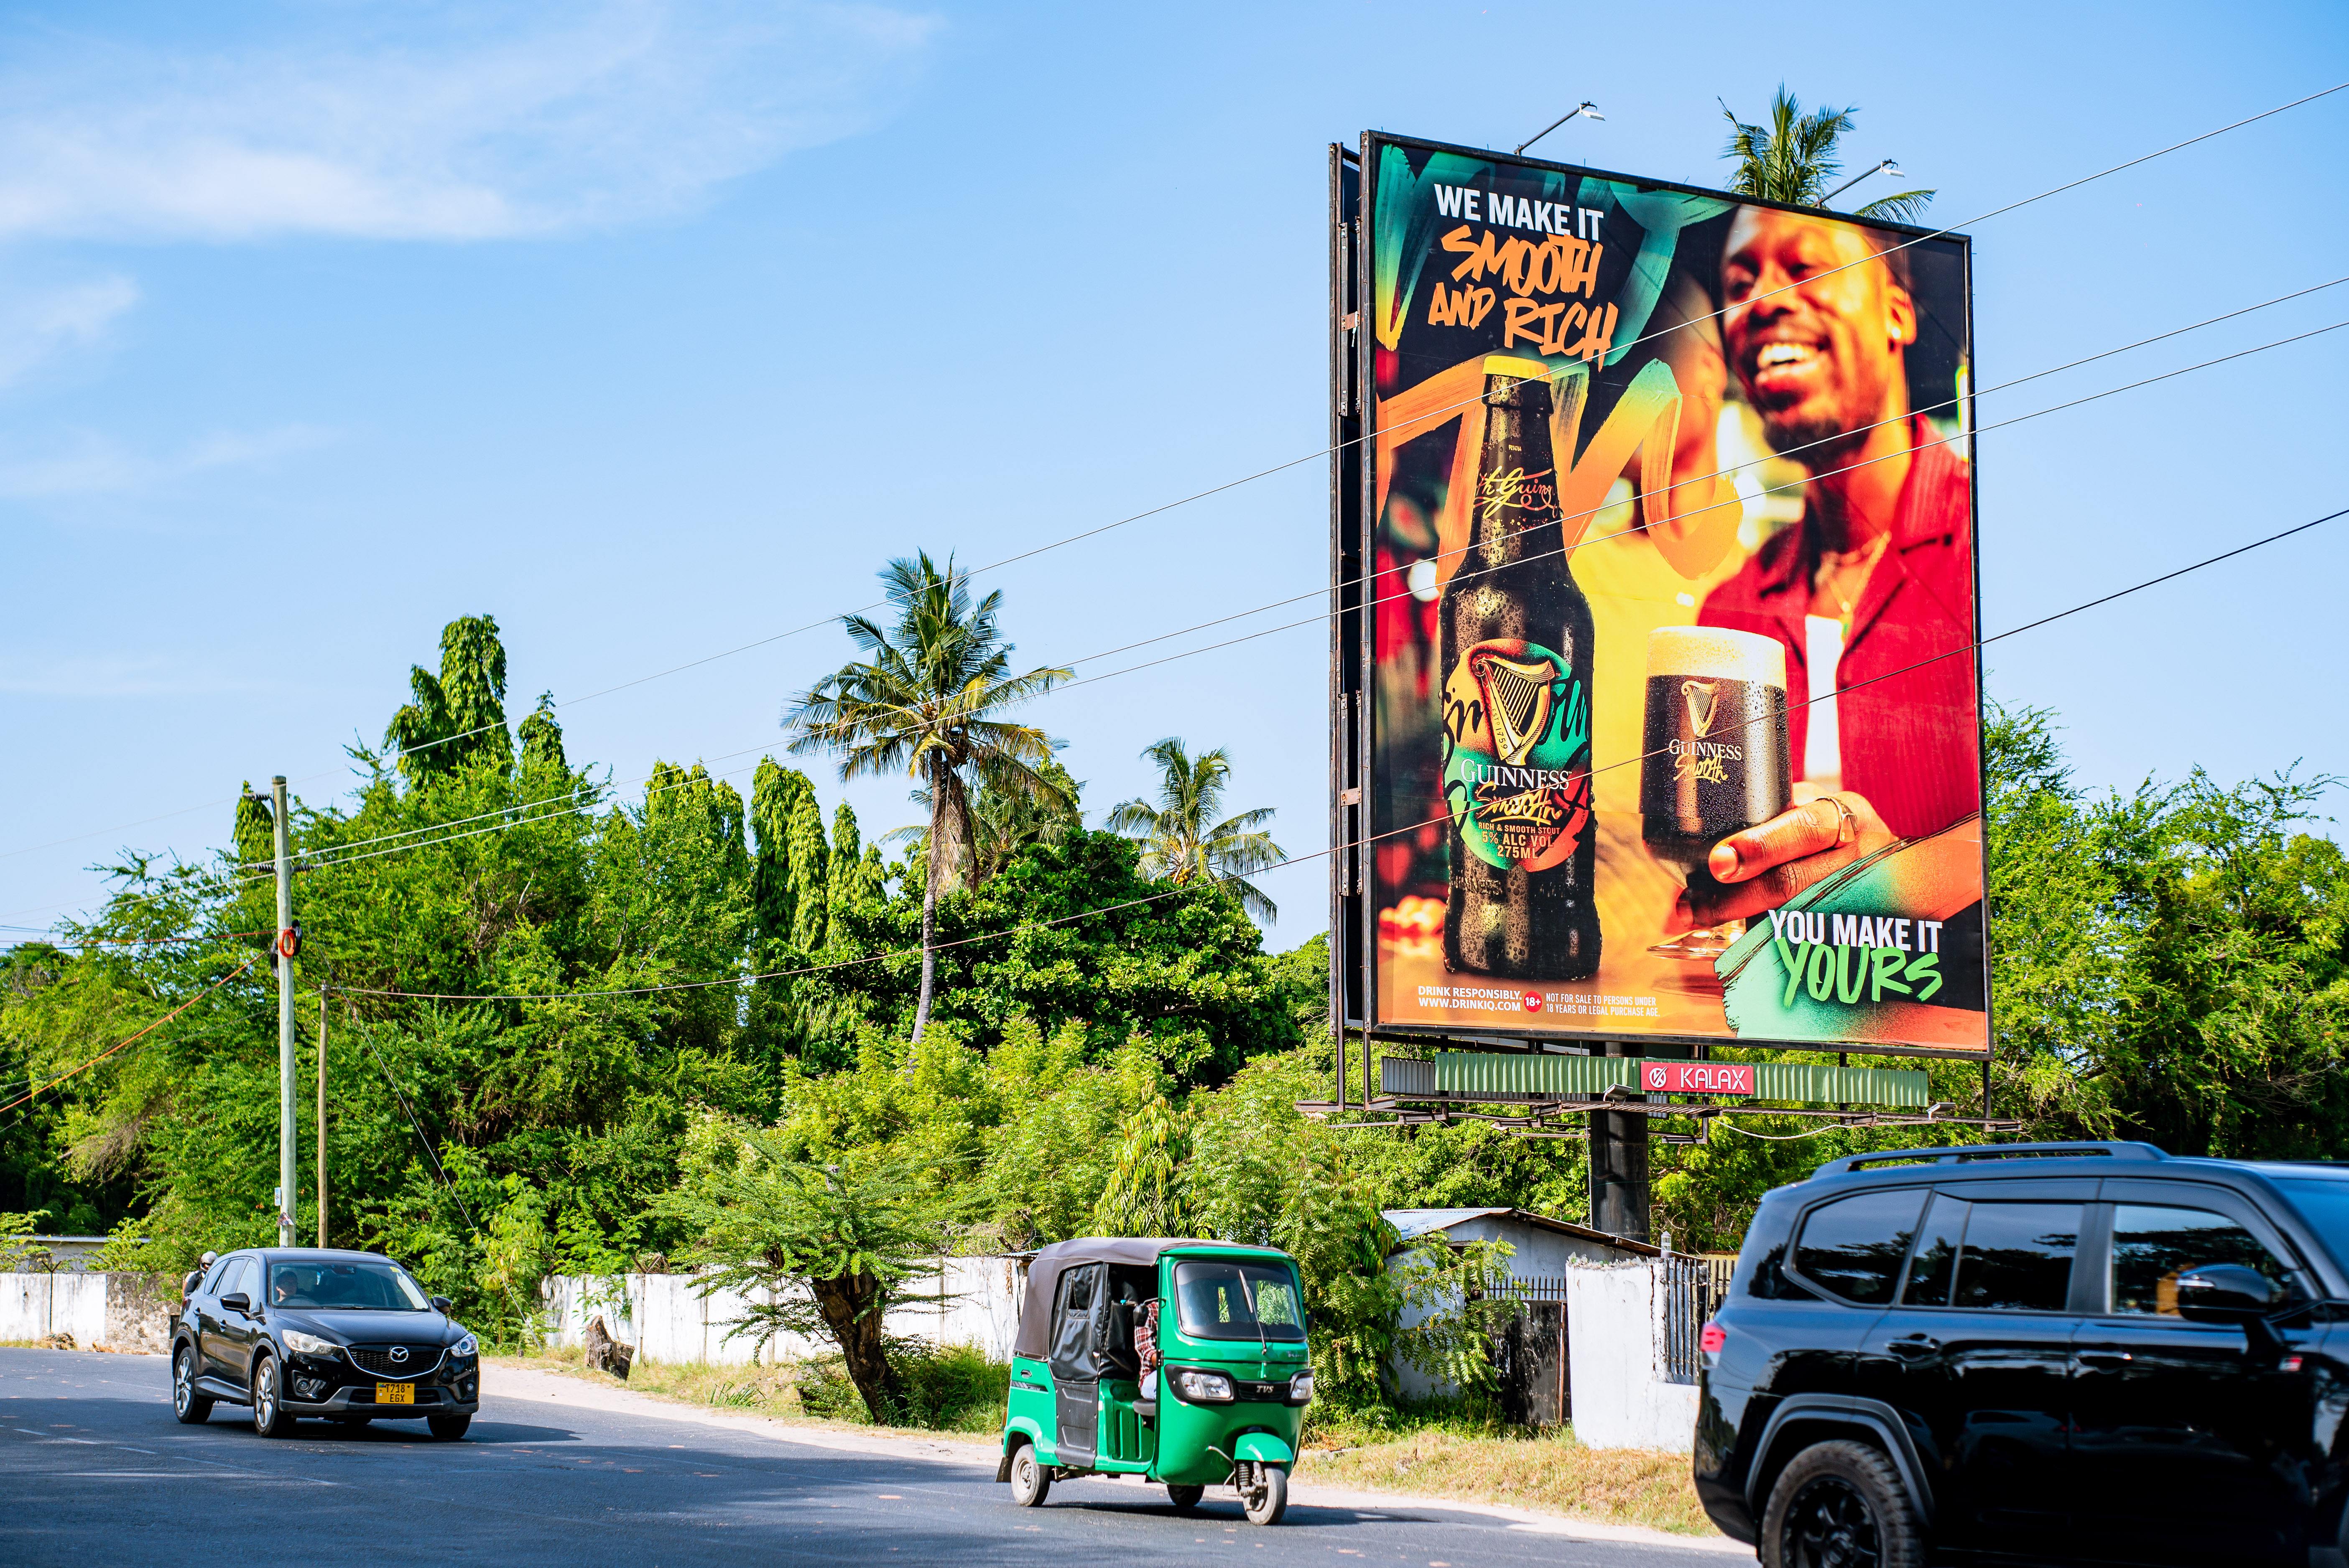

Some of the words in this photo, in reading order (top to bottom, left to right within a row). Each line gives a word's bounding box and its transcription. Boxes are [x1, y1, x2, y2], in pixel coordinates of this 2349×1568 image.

[1434, 184, 1481, 221] WE
[1488, 192, 1570, 235] MAKE
[1578, 207, 1604, 241] IT
[1441, 225, 1603, 298] SMOOTH
[1428, 283, 1495, 329] AND
[1504, 297, 1618, 372] RICH
[1495, 728, 1508, 749] 1759
[1668, 739, 1743, 761] GUINNESS
[1461, 758, 1569, 790] GUINNESS
[1478, 822, 1495, 830] RICH
[1504, 825, 1536, 834] SMOOTH
[1482, 831, 1499, 844] 5%
[1503, 833, 1526, 846] ALC
[1530, 835, 1554, 847] VOL
[1497, 845, 1539, 859] 275ML
[1767, 909, 1825, 945] YOU
[1833, 914, 1911, 951] MAKE
[1918, 920, 1943, 953] IT
[1777, 937, 1943, 1008] YOURS
[1418, 986, 1451, 997] DRINK
[1453, 987, 1522, 1000] RESPONSIBLY.
[1546, 993, 1559, 1002] NOT
[1561, 994, 1573, 1003] FOR
[1576, 994, 1592, 1004] SALE
[1593, 995, 1602, 1005] TO
[1604, 995, 1633, 1005] PERSONS
[1635, 997, 1656, 1006] UNDER
[1418, 997, 1520, 1011] WWW.DRINKIQ.COM
[1525, 997, 1541, 1007] 18+
[1546, 1004, 1553, 1013] 18
[1555, 1004, 1576, 1014] YEARS
[1578, 1005, 1587, 1014] OR
[1589, 1005, 1609, 1015] LEGAL
[1611, 1007, 1644, 1016] PURCHASE
[1646, 1007, 1660, 1017] AGE.
[1681, 1068, 1746, 1091] KALAX
[385, 1384, 405, 1393] T718
[390, 1394, 405, 1402] EGX
